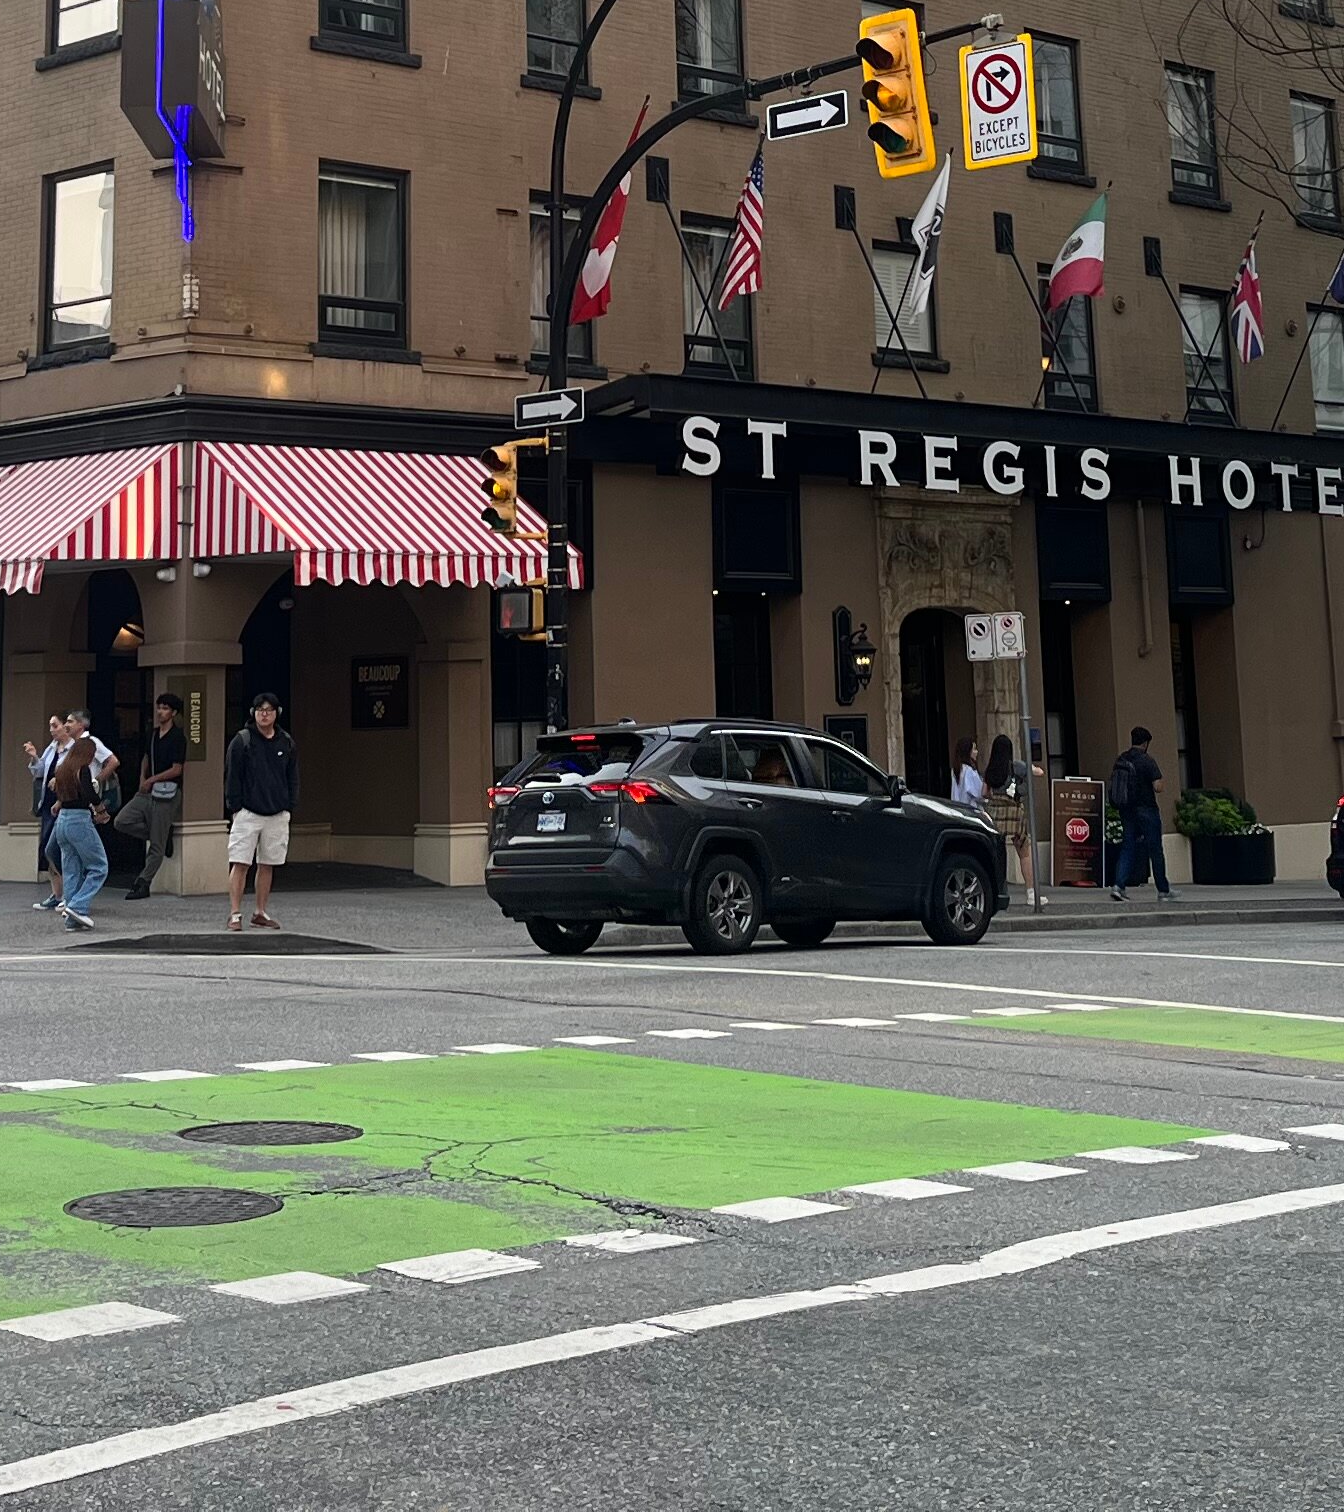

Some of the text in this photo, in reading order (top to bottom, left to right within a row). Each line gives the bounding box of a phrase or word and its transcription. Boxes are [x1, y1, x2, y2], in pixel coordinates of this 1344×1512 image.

[199, 34, 226, 121] HOTEL
[979, 116, 1019, 136] EXCEPT
[975, 132, 1026, 154] BICYCLES
[681, 416, 787, 480] ST
[858, 429, 1112, 500] REGIS
[358, 664, 401, 683] BEAUCOUP
[190, 692, 201, 744] BEAUCOUP
[1067, 825, 1089, 835] STOP
